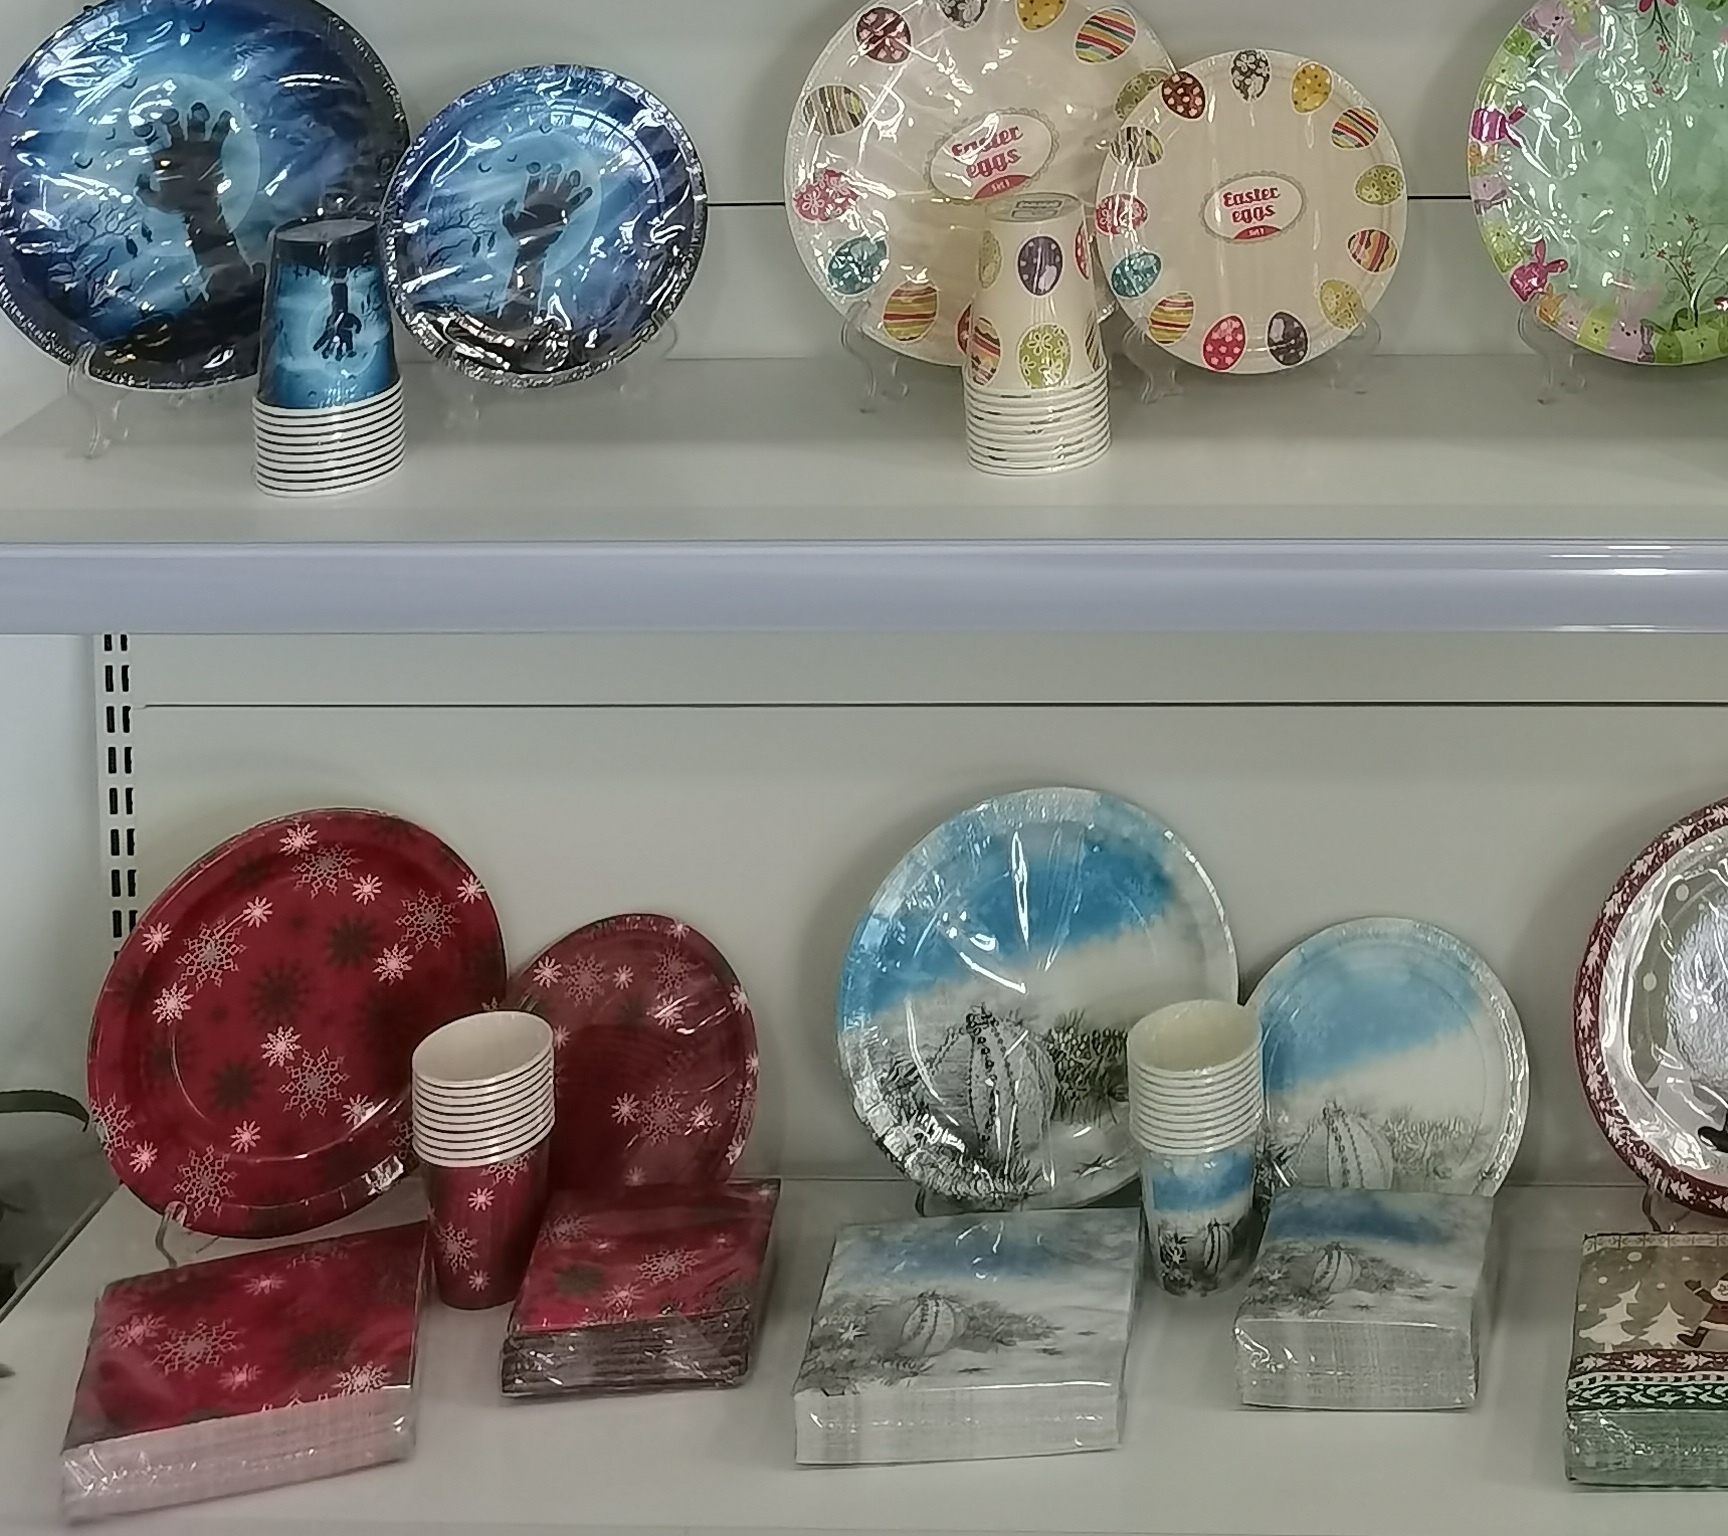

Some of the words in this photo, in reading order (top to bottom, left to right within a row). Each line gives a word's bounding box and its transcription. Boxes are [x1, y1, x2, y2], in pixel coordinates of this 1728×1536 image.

[965, 148, 1022, 178] eggs
[1223, 188, 1281, 207] Easter
[1232, 205, 1276, 223] eggs
